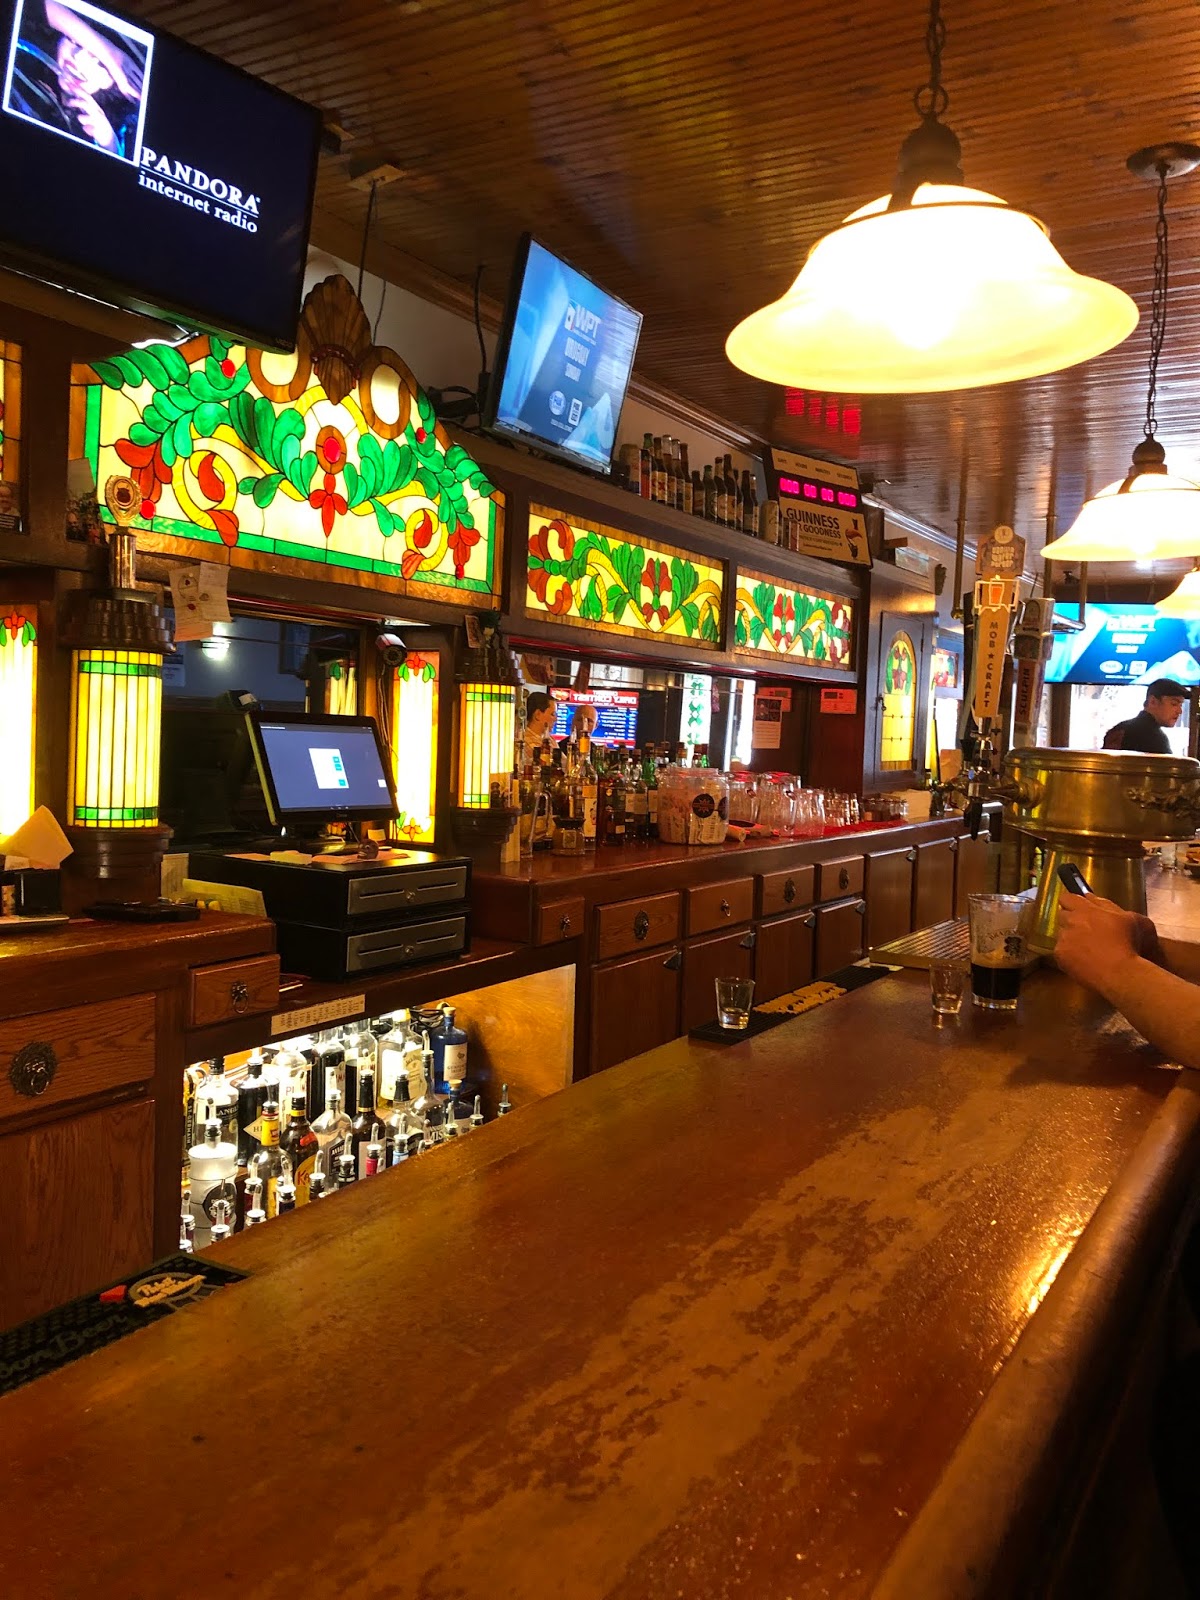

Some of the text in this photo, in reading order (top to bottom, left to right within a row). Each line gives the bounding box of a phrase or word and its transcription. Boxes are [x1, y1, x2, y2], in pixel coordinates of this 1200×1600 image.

[138, 170, 258, 233] internet radio
[140, 146, 260, 215] PANDORA
[786, 507, 840, 530] GUINNESS
[804, 524, 842, 539] GOODNESS
[983, 621, 999, 708] MOB CRAFT
[1020, 668, 1030, 716] SCULPIN
